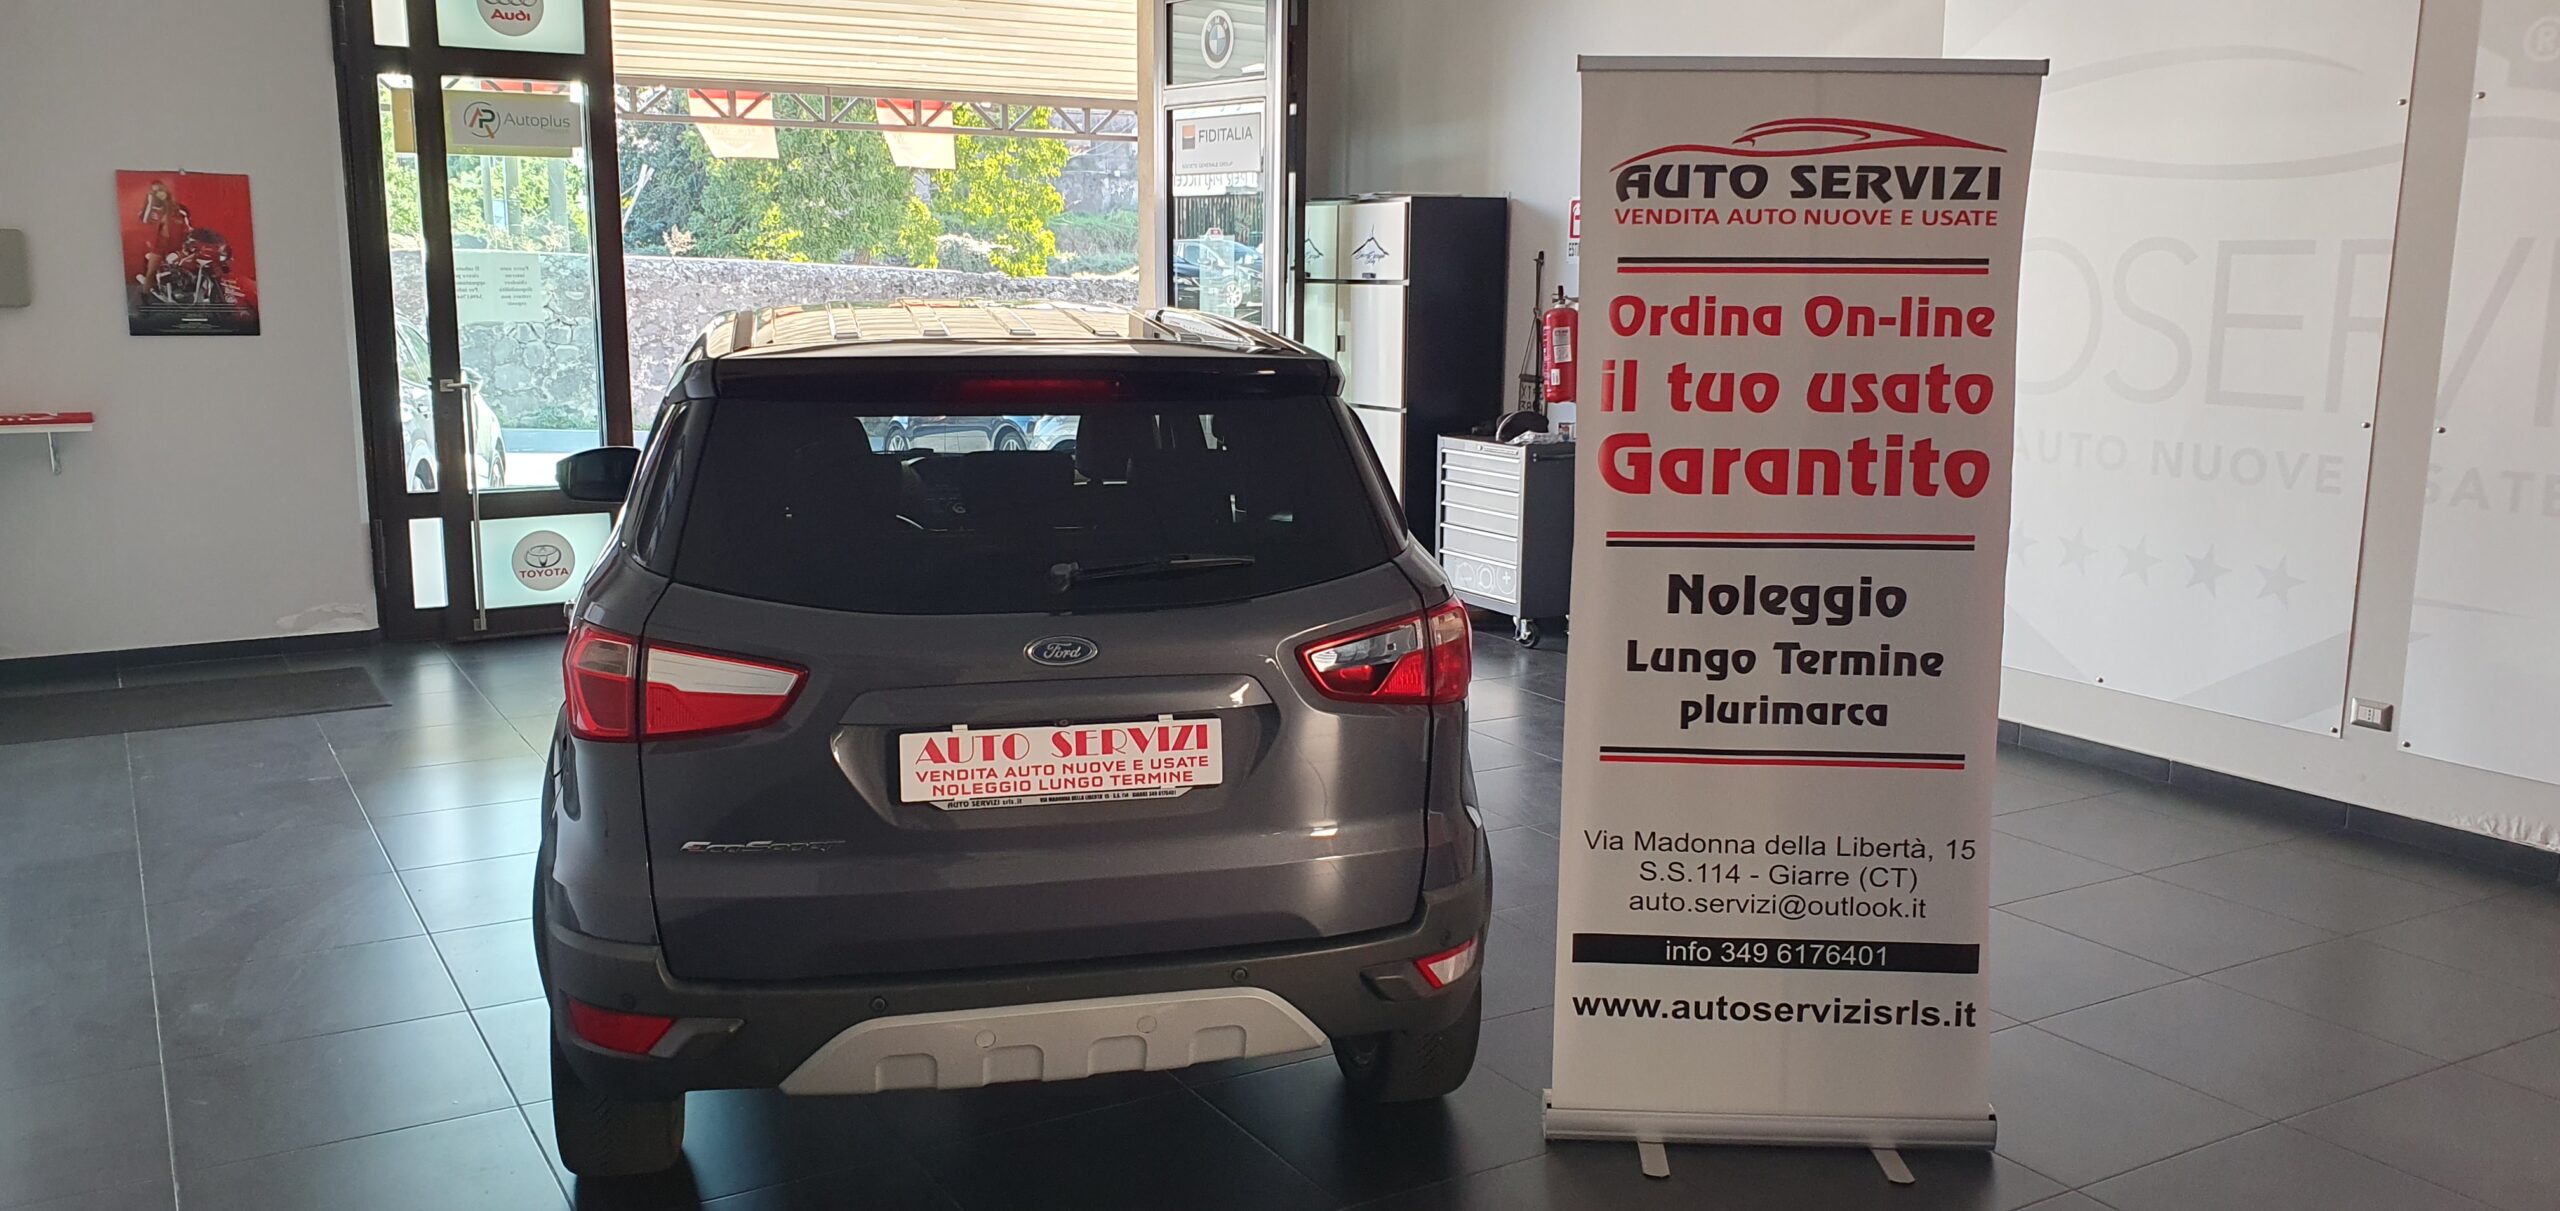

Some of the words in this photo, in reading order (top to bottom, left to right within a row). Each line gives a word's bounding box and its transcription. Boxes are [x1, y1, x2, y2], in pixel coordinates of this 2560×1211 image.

[490, 9, 531, 21] Audi
[503, 112, 571, 129] Autoplus
[1198, 125, 1254, 143] FIDITALIA
[1614, 164, 1769, 202] AUTO
[1789, 165, 2001, 203] SERVIZI
[1614, 208, 1721, 225] VENDITA
[1726, 208, 1797, 225] AUTO
[1803, 208, 1893, 226] NUOVE
[1901, 209, 1913, 226] E
[1921, 209, 1999, 226] USATE
[1608, 295, 1782, 337] Ordina
[1804, 295, 1996, 337] On-line
[1600, 359, 1639, 412] il
[1667, 362, 1780, 413] tuo
[1806, 363, 1994, 414] usato
[1597, 432, 1990, 497] Garantito
[2148, 439, 2346, 496] NUOVE
[519, 567, 569, 579] TOYOTA
[1666, 573, 1907, 626] Noleggio
[1043, 642, 1082, 659] Ford
[1626, 639, 1757, 681] Lungo
[1772, 641, 1944, 677] Termine
[1680, 693, 1888, 730] plurimarca
[915, 733, 1030, 765] AUTO
[1051, 724, 1208, 758] SERVIZI
[915, 768, 999, 783] VENDITA
[1004, 764, 1055, 778] AUTO
[1062, 760, 1126, 775] NUOVE
[1133, 759, 1144, 771] E
[1150, 755, 1209, 770] USATE
[932, 780, 1031, 797] NOLEGGIO
[1039, 775, 1103, 791] LUNGO
[1109, 770, 1193, 786] TERMINE
[971, 799, 1000, 807] SERVIZI
[1583, 830, 1624, 851] Via
[1634, 831, 1755, 855] Madonna
[1765, 835, 1827, 856] della
[1836, 836, 1934, 862] Libertà,
[1946, 839, 1976, 860] 15
[1638, 861, 1740, 884] S.S.114
[1768, 865, 1849, 887] Giarre
[1859, 866, 1918, 893] (CT)
[1628, 892, 1927, 920] auto.servizi@outlook.it
[1665, 940, 1712, 962] info
[1720, 942, 1768, 963] 349
[1776, 943, 1888, 966] 6176401
[1572, 995, 1976, 1027] www.autoservizisrls.it
